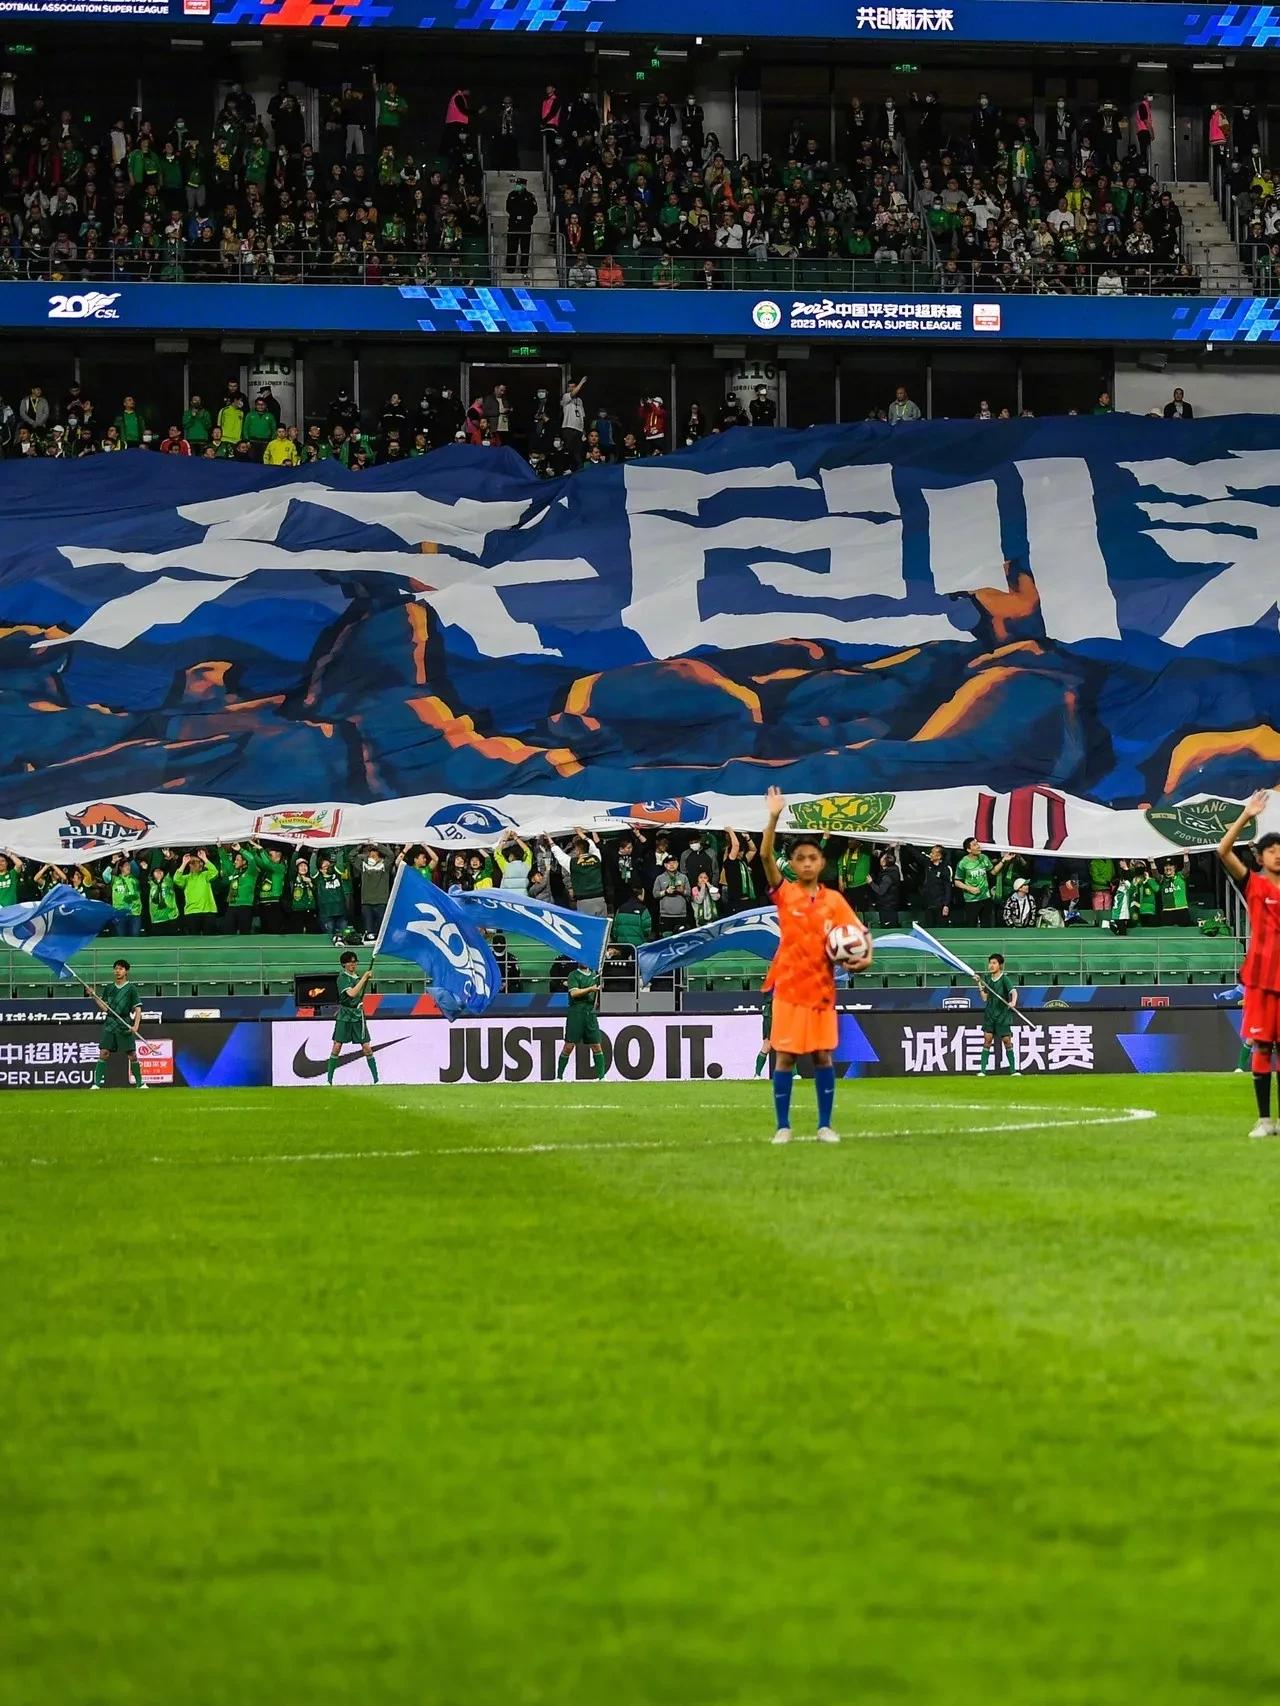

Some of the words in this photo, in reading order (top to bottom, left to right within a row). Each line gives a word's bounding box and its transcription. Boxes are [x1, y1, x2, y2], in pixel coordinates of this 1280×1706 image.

[41, 4, 102, 13] ASSOCIATION
[103, 5, 132, 14] SUPER
[133, 6, 169, 14] LEAGUE
[856, 7, 954, 31] 共创新未来
[95, 309, 120, 318] CSL
[791, 319, 816, 329] 2023
[818, 320, 843, 329] PING
[844, 320, 859, 329] AN
[862, 320, 884, 330] CFA
[884, 320, 920, 330] SUPER
[920, 321, 962, 331] LEAGUE
[0, 1042, 101, 1065] 中超联赛
[440, 1026, 566, 1082] JUST
[665, 1024, 723, 1079] IT.
[901, 1025, 1094, 1072] 诚信联赛
